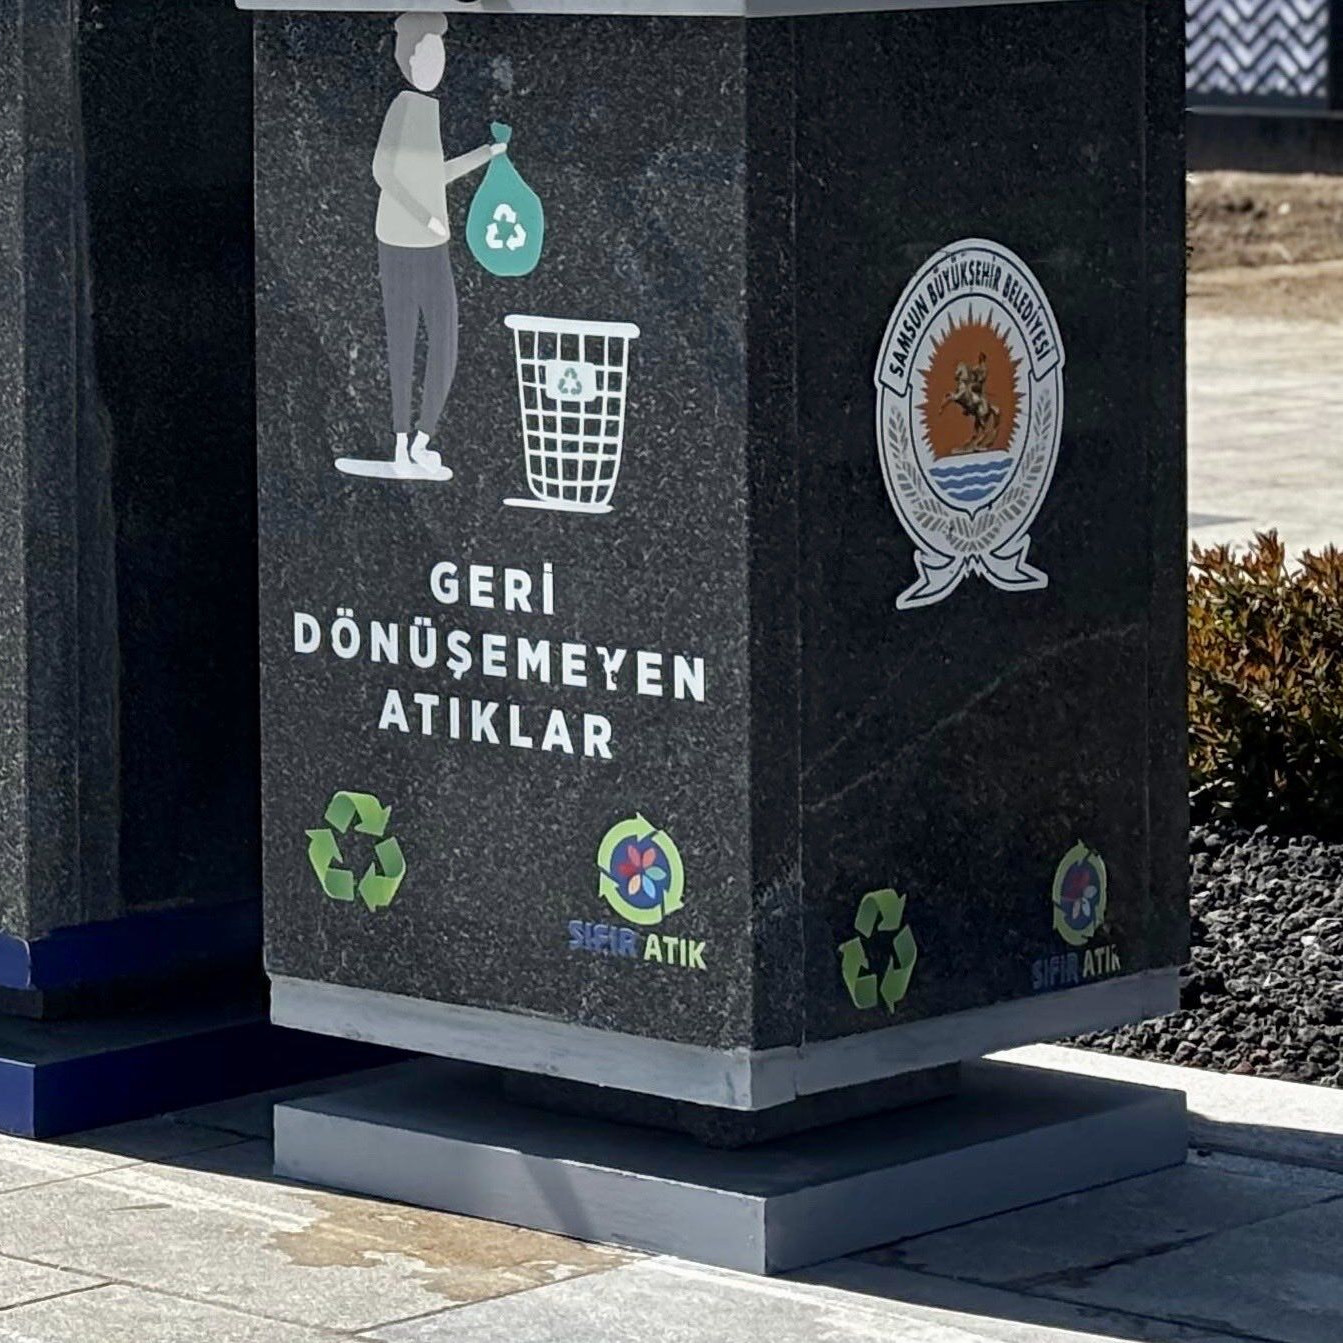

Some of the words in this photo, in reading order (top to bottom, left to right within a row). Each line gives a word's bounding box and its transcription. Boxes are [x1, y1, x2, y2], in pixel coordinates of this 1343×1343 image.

[889, 293, 930, 378] SAMSUN
[926, 256, 1003, 307] BÜYÜKŞEHİR
[1002, 274, 1055, 362] BELEDİYESİ
[430, 561, 555, 616] GERİ
[293, 607, 706, 703] DÖNÜŞEMEYEN
[377, 688, 613, 760] ATIKLAR
[643, 933, 707, 972] ATIK
[1082, 944, 1121, 979] ATIK
